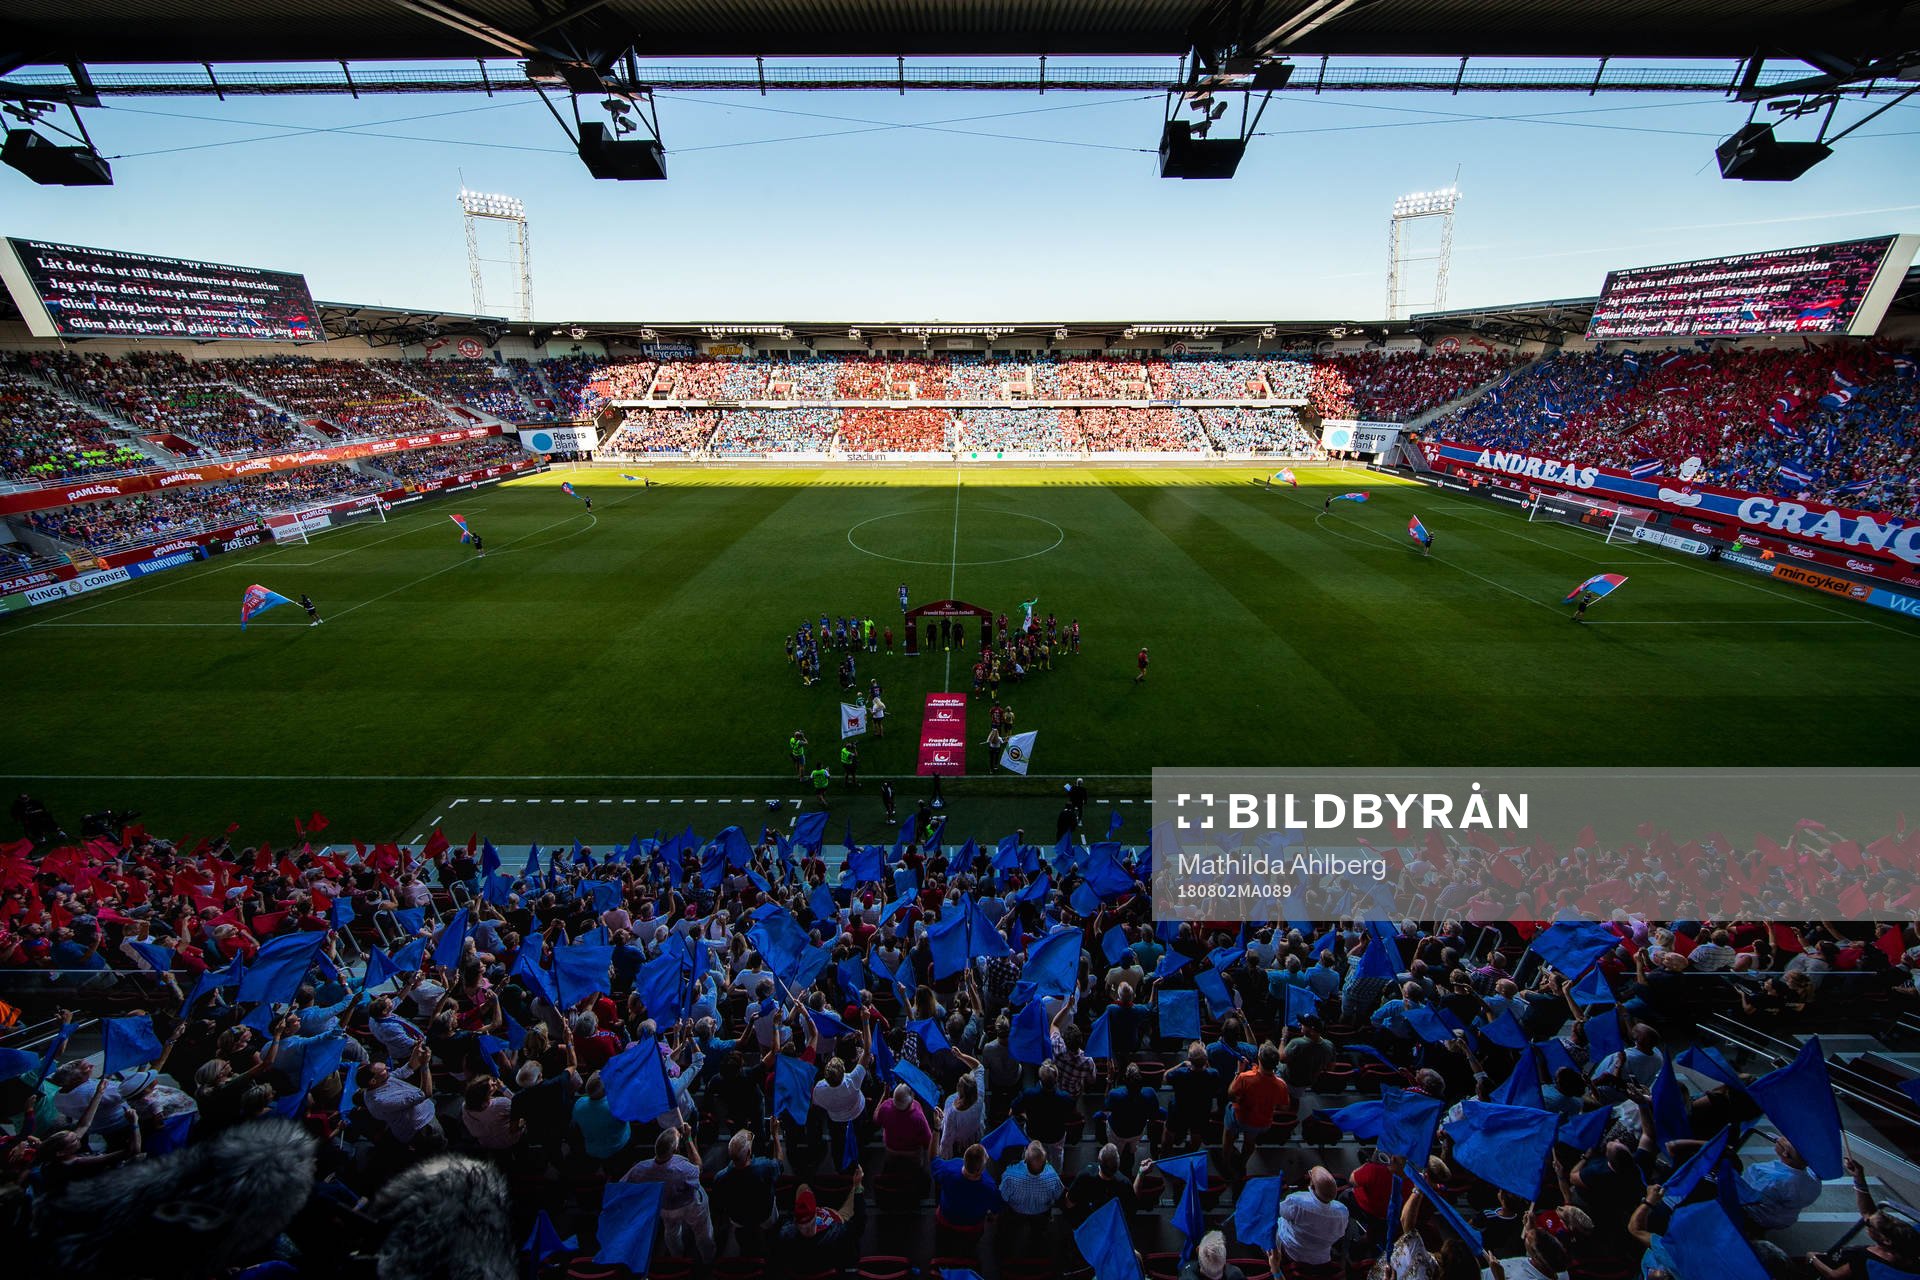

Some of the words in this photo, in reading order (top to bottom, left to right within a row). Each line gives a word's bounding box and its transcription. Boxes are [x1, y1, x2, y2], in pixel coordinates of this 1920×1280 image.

[37, 257, 64, 270] Låt
[66, 260, 90, 273] det
[91, 263, 115, 275] eka
[115, 268, 131, 277] ut
[131, 267, 151, 279] till
[151, 269, 231, 287] stadsbussarnas
[231, 279, 279, 292] slutstation
[1611, 281, 1626, 292] Låt
[1625, 279, 1640, 290] det
[1640, 278, 1657, 288] eka
[1656, 278, 1667, 286] ut
[1667, 275, 1684, 286] till
[1684, 267, 1764, 284] stadsbussarnas
[1762, 261, 1830, 277] slutstation
[49, 278, 77, 293] Jag
[77, 281, 117, 294] viskar
[119, 284, 141, 295] det
[148, 287, 172, 298] örat
[174, 289, 190, 300] på
[189, 291, 209, 300] min
[211, 294, 249, 304] sovande
[250, 297, 266, 305] son
[1606, 297, 1620, 307] Jag
[1620, 294, 1646, 305] viskar
[1647, 291, 1662, 302] det
[1668, 291, 1687, 301] örat
[1687, 288, 1701, 301] på
[1702, 289, 1723, 298] min
[1724, 284, 1768, 297] sovande
[1769, 283, 1791, 293] son
[60, 298, 96, 310] Glöm
[98, 300, 137, 314] aldrig
[137, 301, 163, 314] bort
[162, 305, 182, 315] var
[184, 306, 198, 316] du
[200, 307, 239, 319] kommer
[239, 309, 263, 320] ifrån
[1601, 310, 1621, 320] Glöm
[1621, 308, 1646, 321] aldrig
[1646, 307, 1667, 317] bort
[1667, 308, 1684, 317] var
[1684, 305, 1697, 315] du
[1697, 303, 1742, 315] kommer
[1741, 302, 1770, 313] ifrån
[69, 317, 106, 330] Glöm
[107, 318, 145, 333] aldrig
[144, 320, 170, 331] bort
[172, 321, 187, 332] all
[188, 322, 218, 335] glädje
[220, 325, 237, 334] och
[238, 325, 251, 336] all
[1596, 325, 1616, 335] Glöm
[1616, 323, 1640, 335] aldrig
[1640, 322, 1662, 333] bort
[1661, 321, 1675, 332] all
[1704, 320, 1722, 330] och
[1723, 320, 1738, 332] all
[1739, 319, 1767, 331] sorg,
[1768, 318, 1799, 331] sorg,
[552, 432, 587, 441] Resurs
[554, 440, 579, 450] Bank
[1350, 440, 1374, 450] Bank
[1352, 431, 1387, 441] Resurs
[235, 462, 272, 475] RAMLÖSA
[1475, 449, 1600, 489] ANDREAS
[160, 471, 204, 487] RAMLÖSA
[67, 485, 121, 502] RAMLÖSA
[153, 540, 200, 558] RAMLÖSA
[137, 551, 194, 574] NORRVIDING
[1846, 559, 1876, 573] Carlsberg
[27, 585, 68, 602] KINGS
[84, 570, 129, 587] CORNER
[1778, 566, 1807, 582] min
[1807, 573, 1852, 593] cykel
